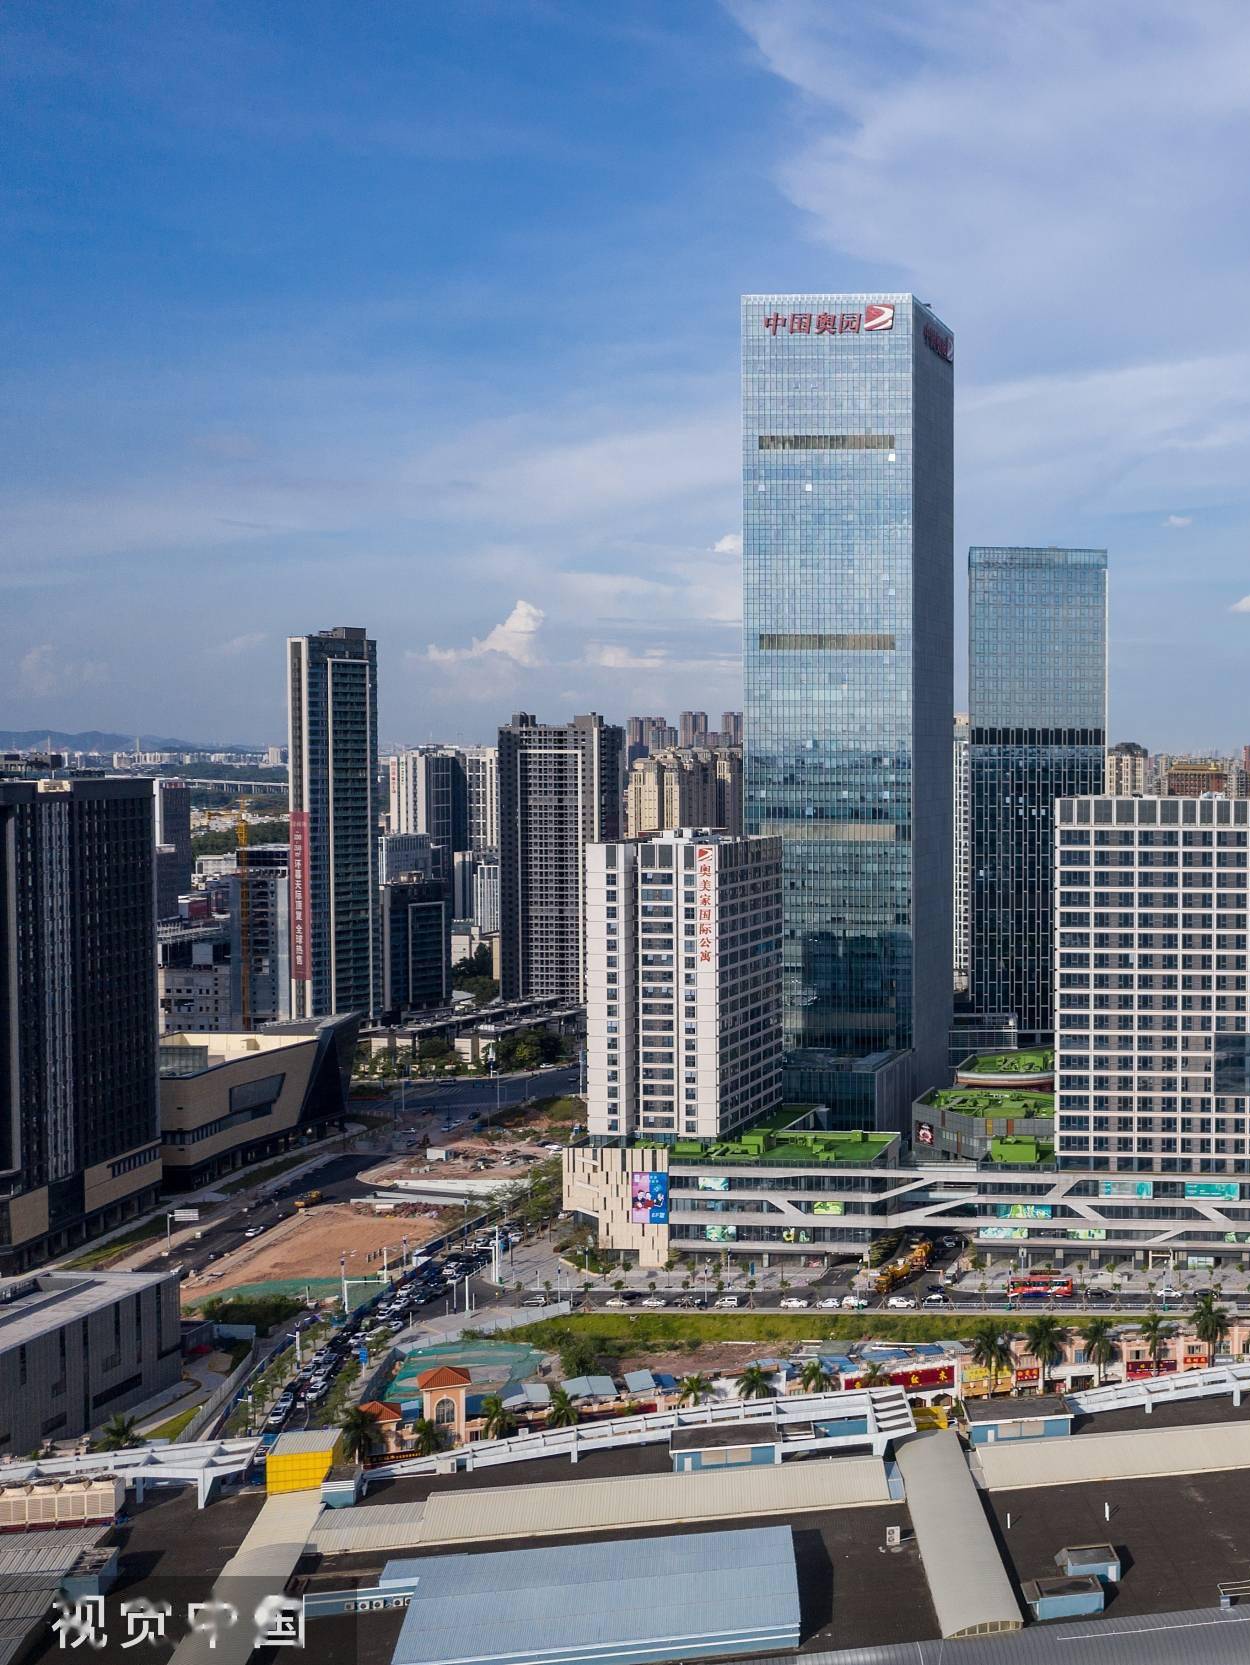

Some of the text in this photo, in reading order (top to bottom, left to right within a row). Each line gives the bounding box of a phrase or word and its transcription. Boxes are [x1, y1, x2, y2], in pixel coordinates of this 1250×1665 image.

[763, 312, 862, 336] 中国奥园
[699, 863, 712, 962] 奥美家国际公寓
